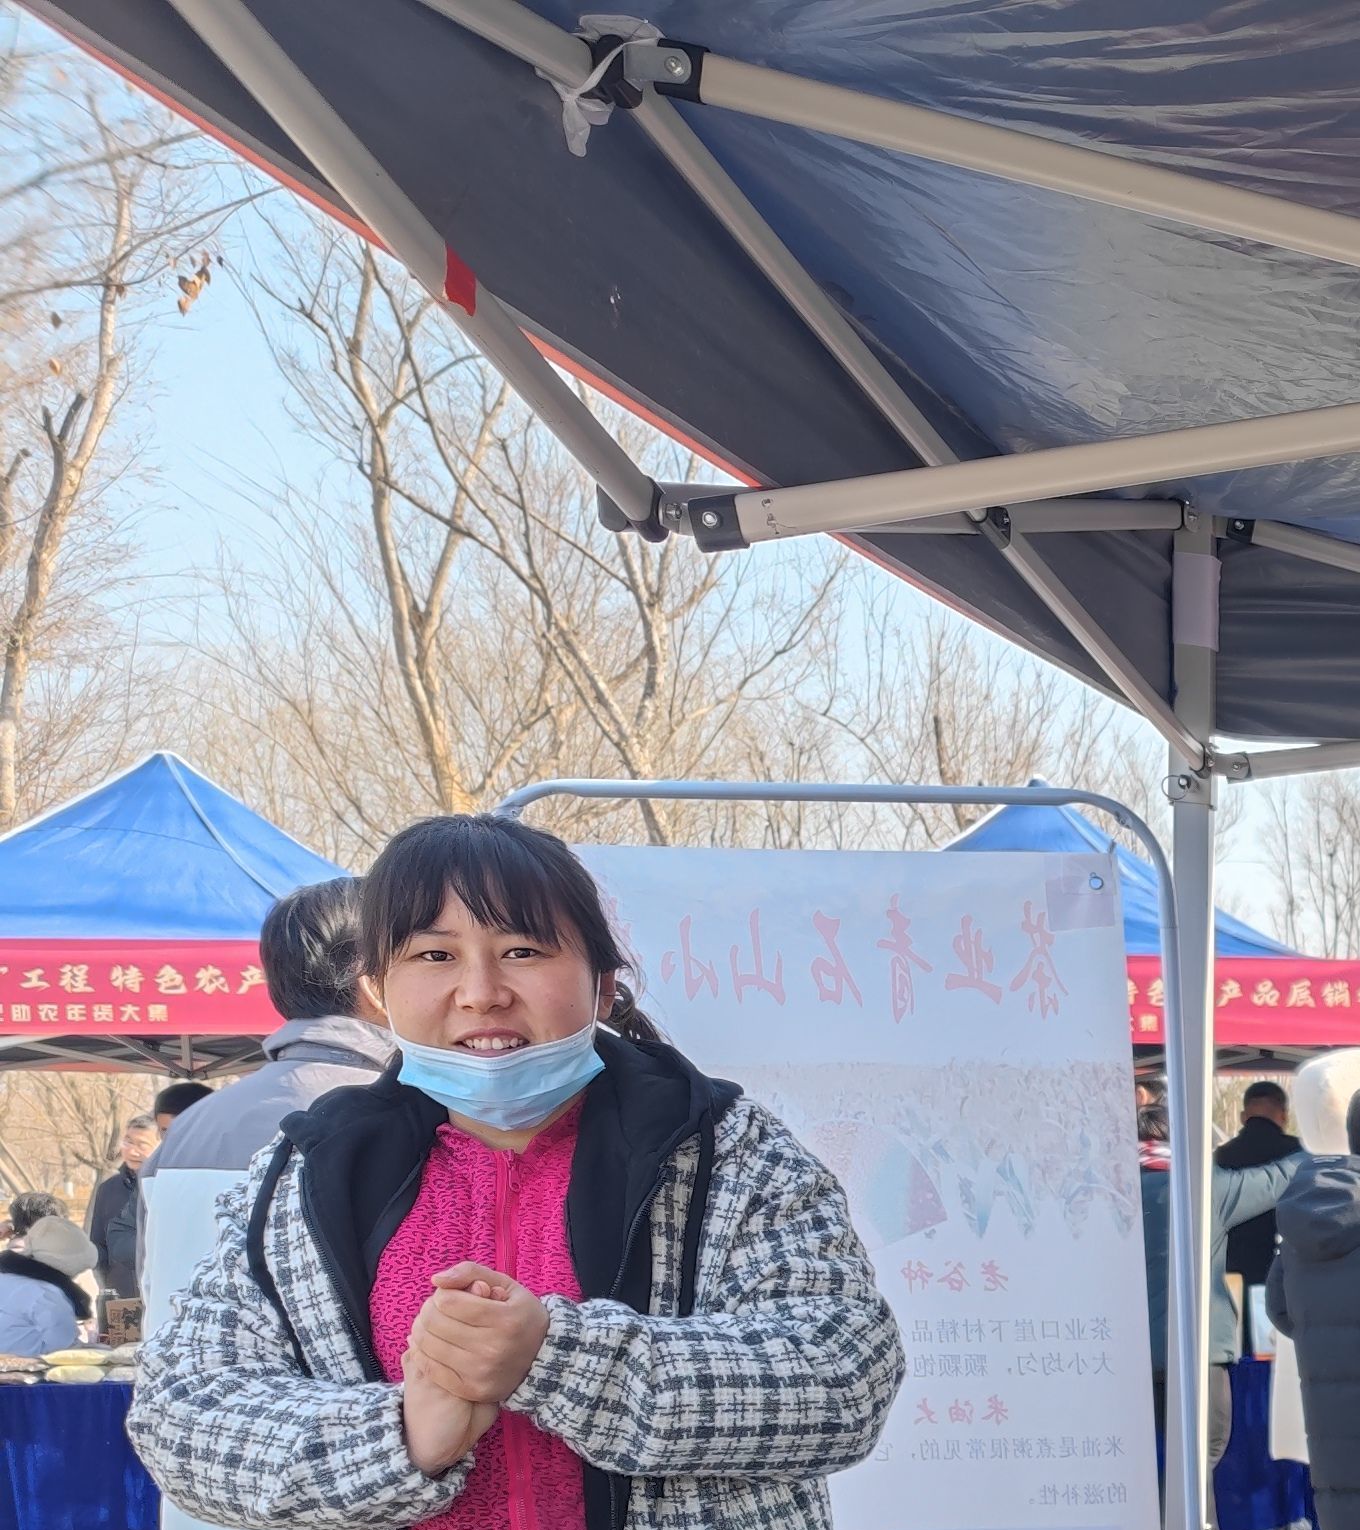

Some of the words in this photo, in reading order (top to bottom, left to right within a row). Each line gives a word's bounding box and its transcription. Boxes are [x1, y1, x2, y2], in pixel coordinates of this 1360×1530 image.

[0, 1003, 169, 1023] 助农年货大集
